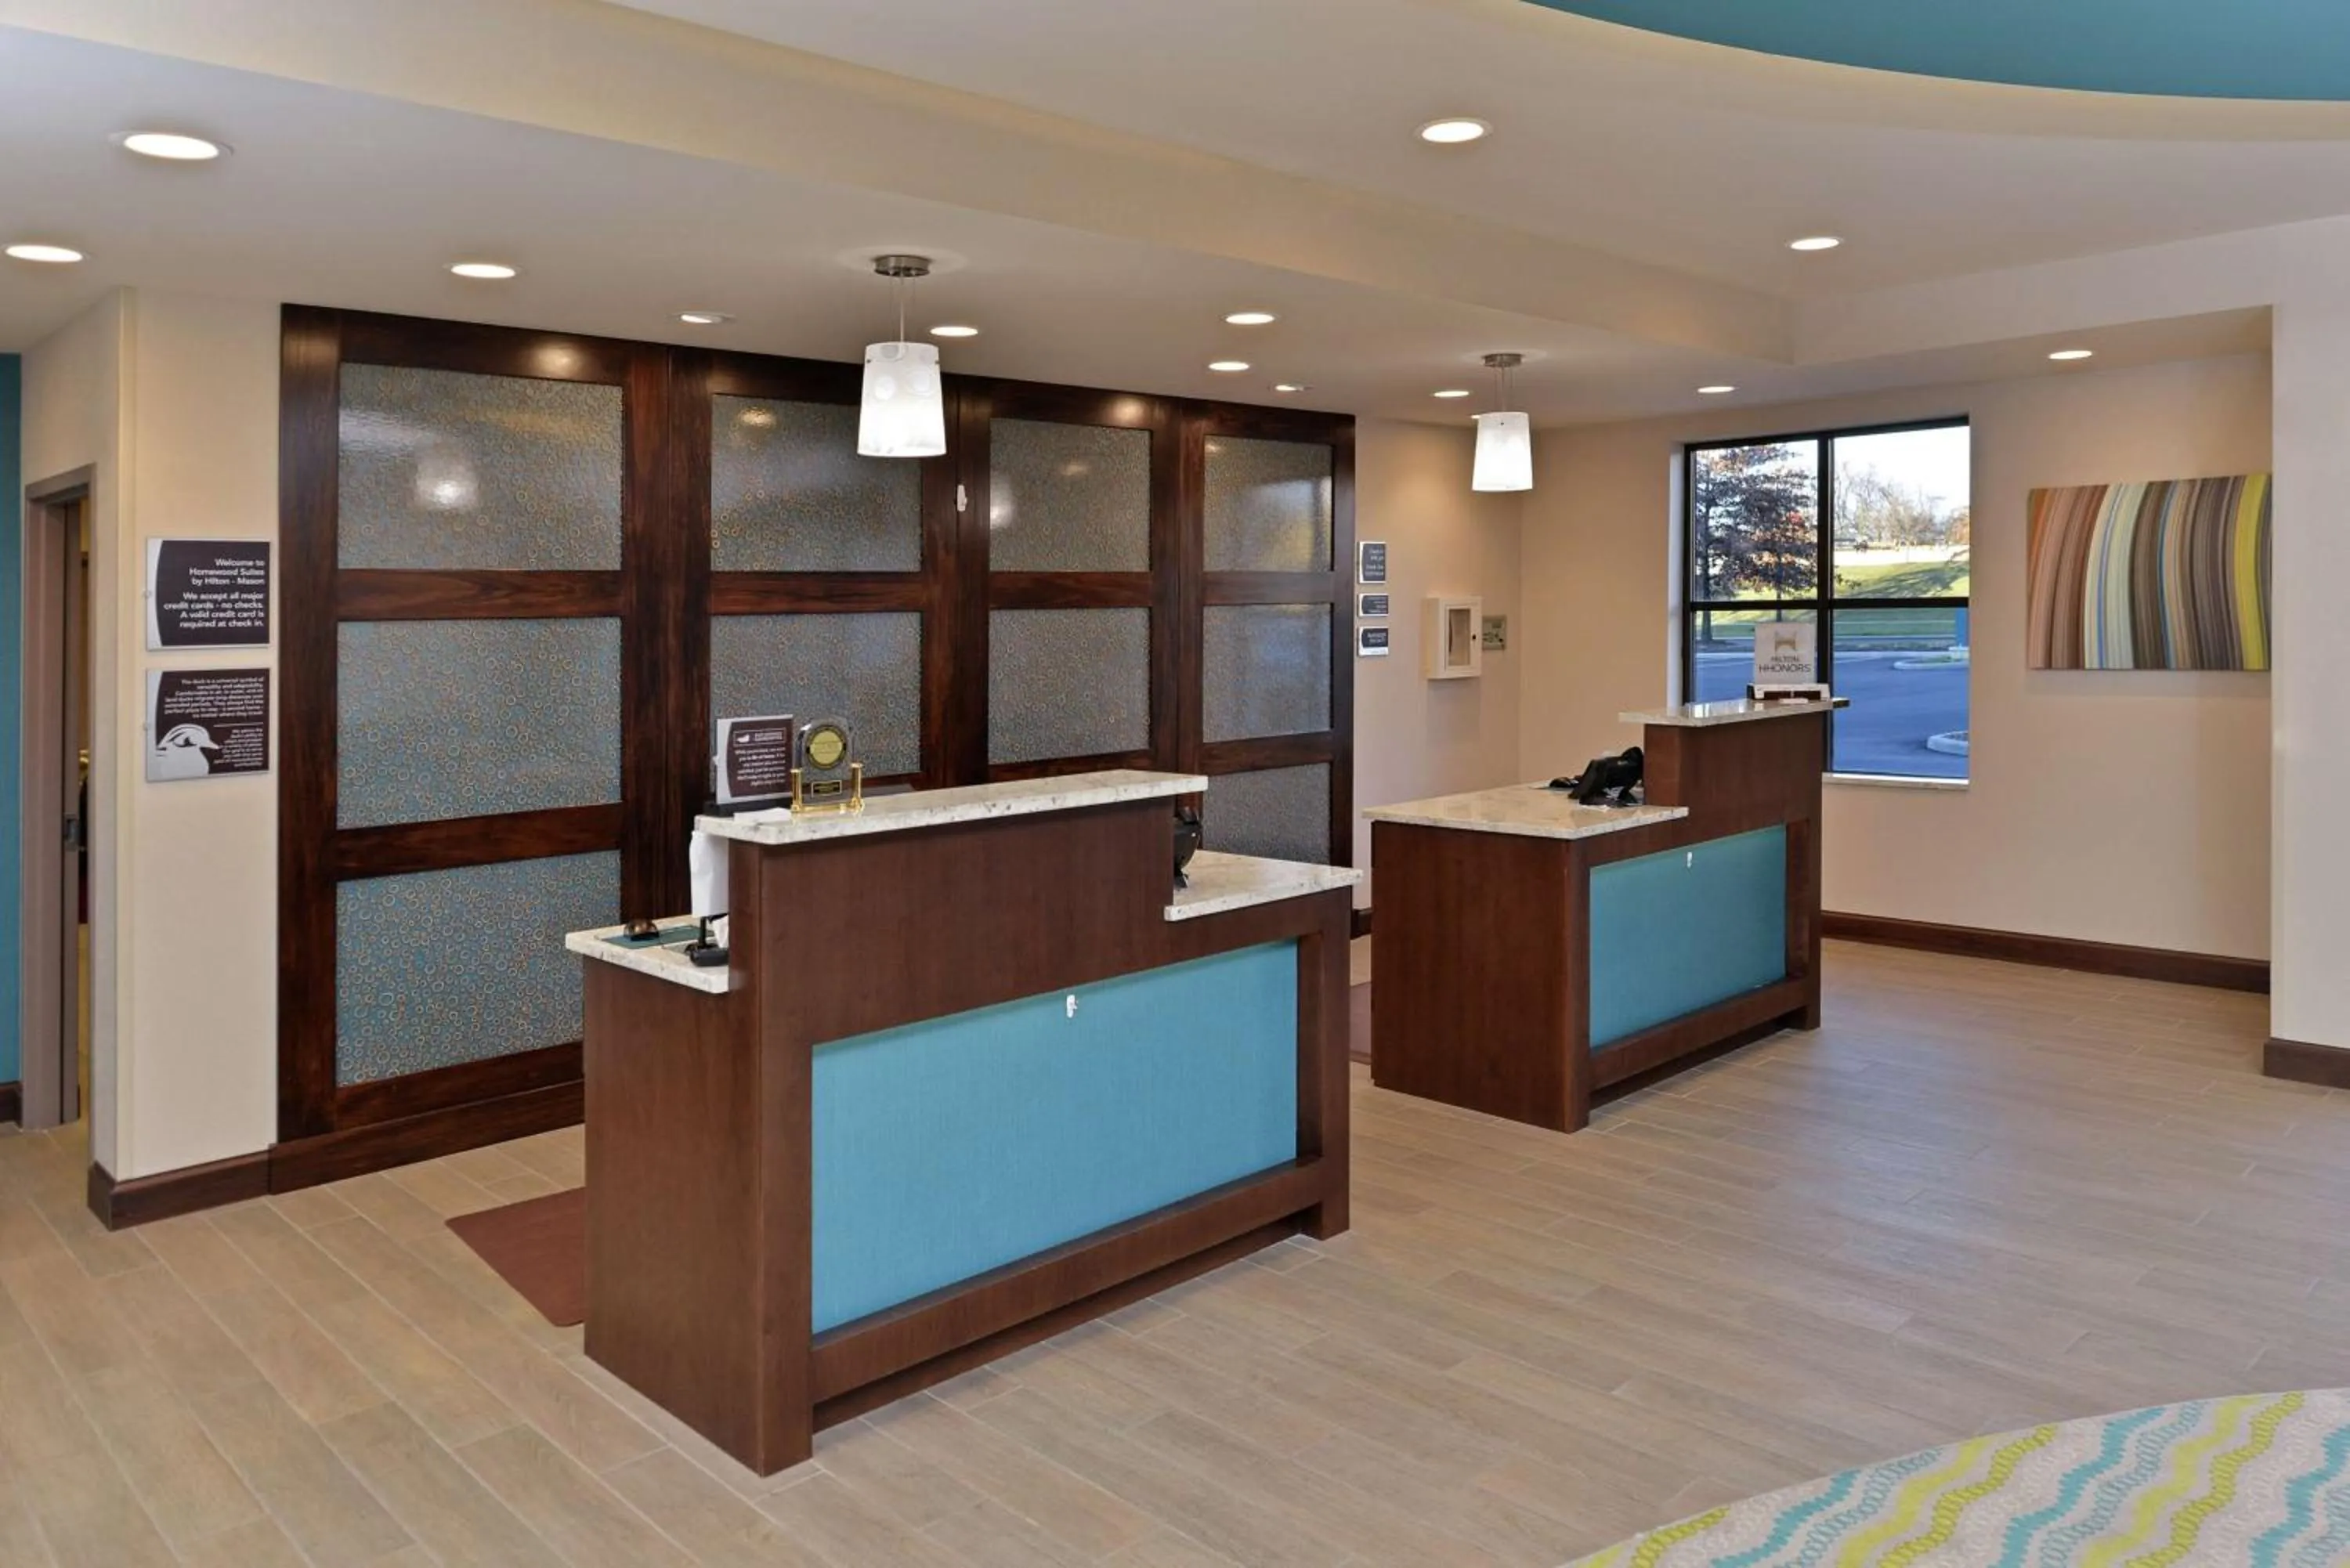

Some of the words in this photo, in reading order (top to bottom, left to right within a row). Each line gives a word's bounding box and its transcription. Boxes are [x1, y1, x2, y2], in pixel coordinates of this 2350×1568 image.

[214, 558, 254, 566] Welcome
[200, 593, 227, 602] accept
[241, 592, 264, 601] major
[163, 601, 189, 610] credit
[179, 620, 216, 629] required
[228, 619, 251, 627] check
[1759, 663, 1811, 673] HHONORS
